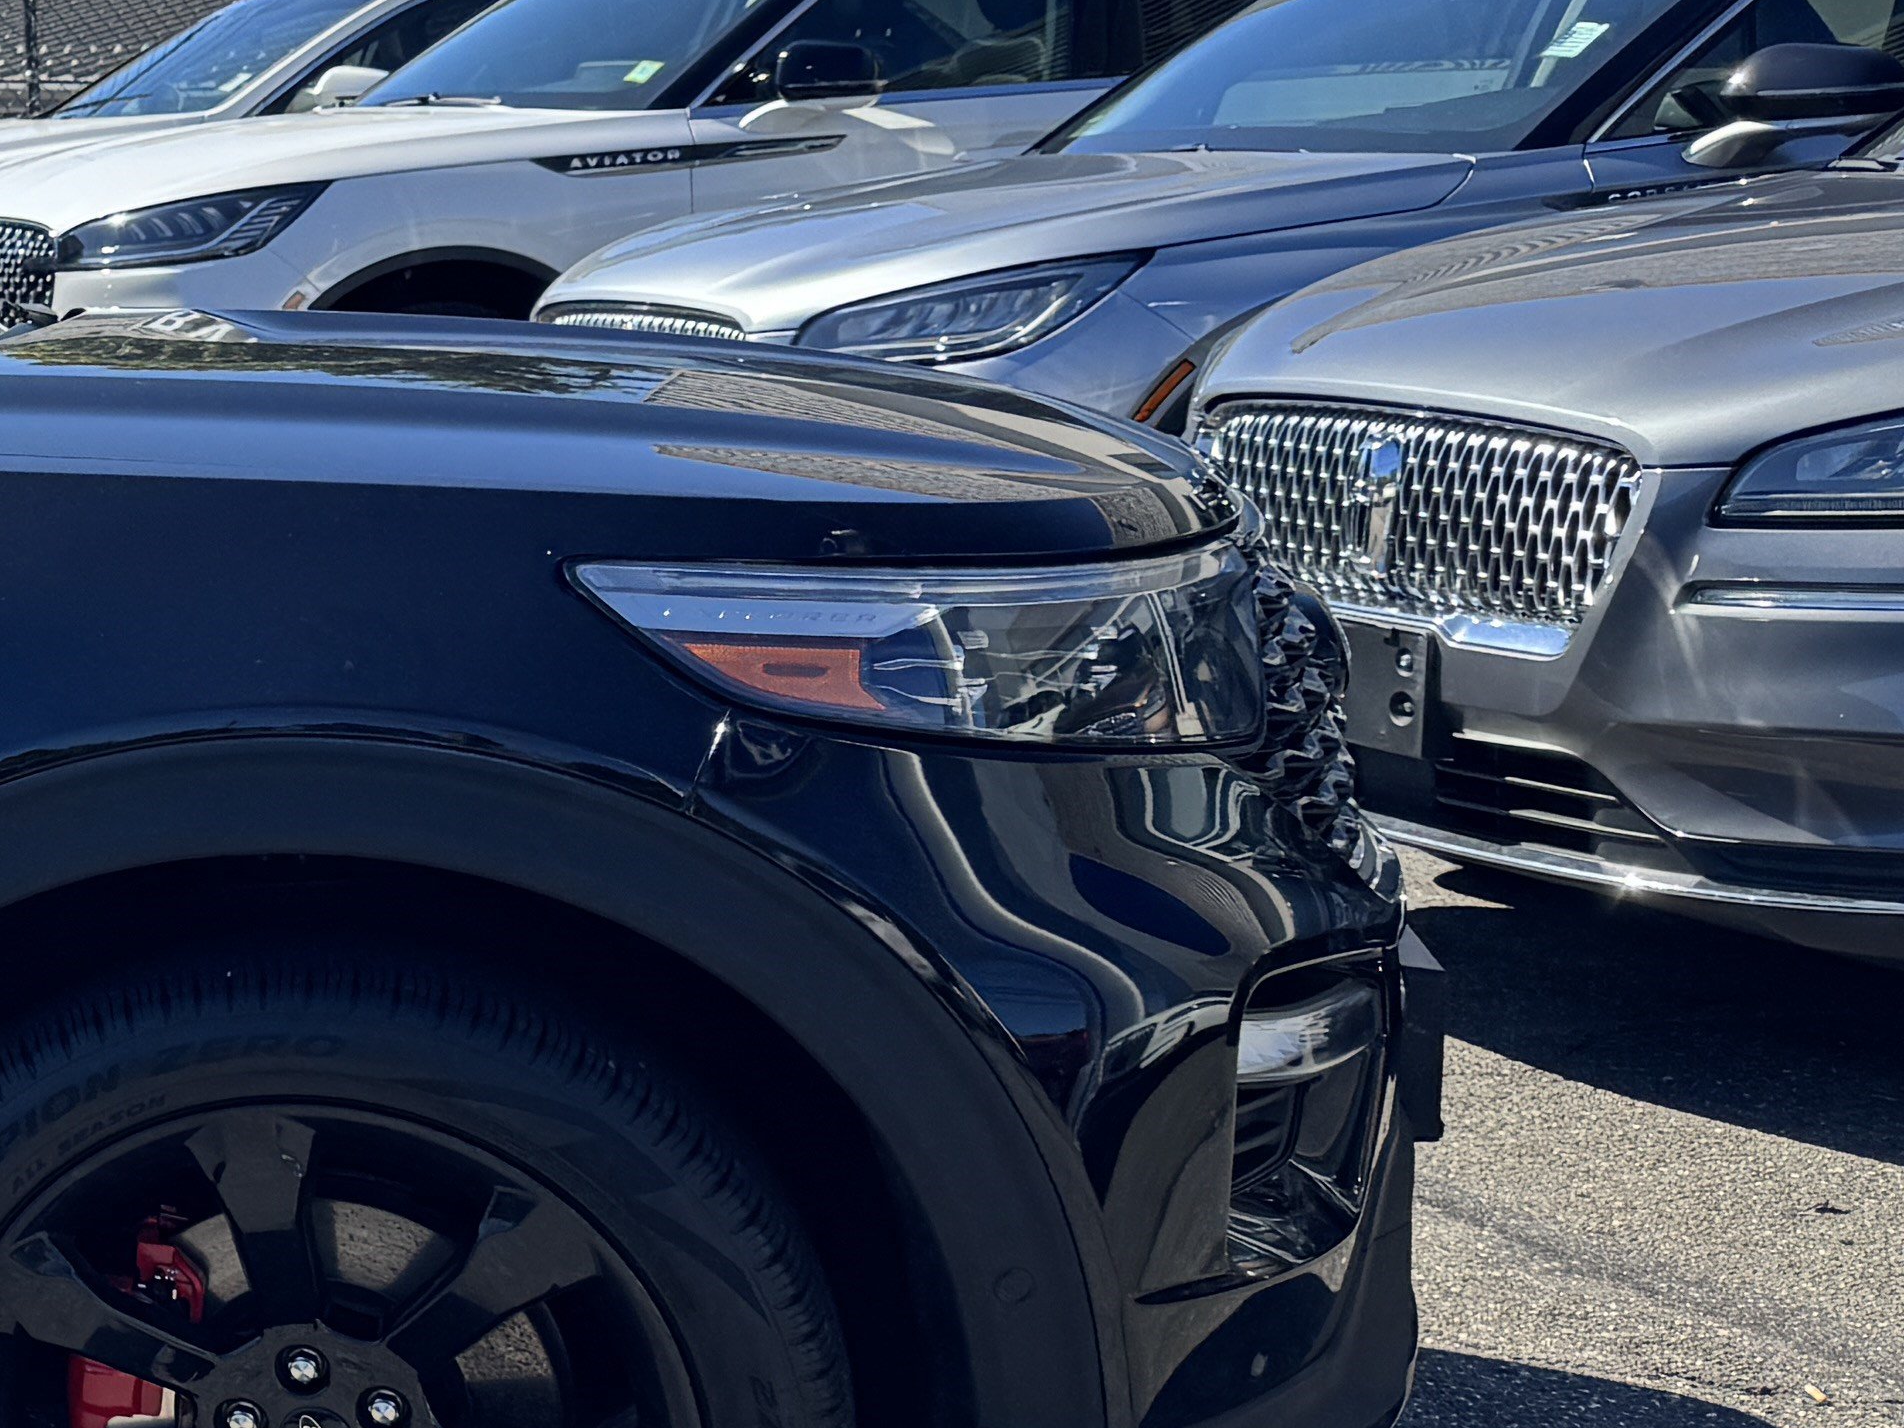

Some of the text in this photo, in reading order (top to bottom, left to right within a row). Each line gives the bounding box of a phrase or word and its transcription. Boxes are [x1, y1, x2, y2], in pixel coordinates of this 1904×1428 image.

[570, 148, 681, 169] AVIATOR
[149, 1033, 347, 1076] ZERO
[12, 1093, 168, 1195] ALL SEASON
